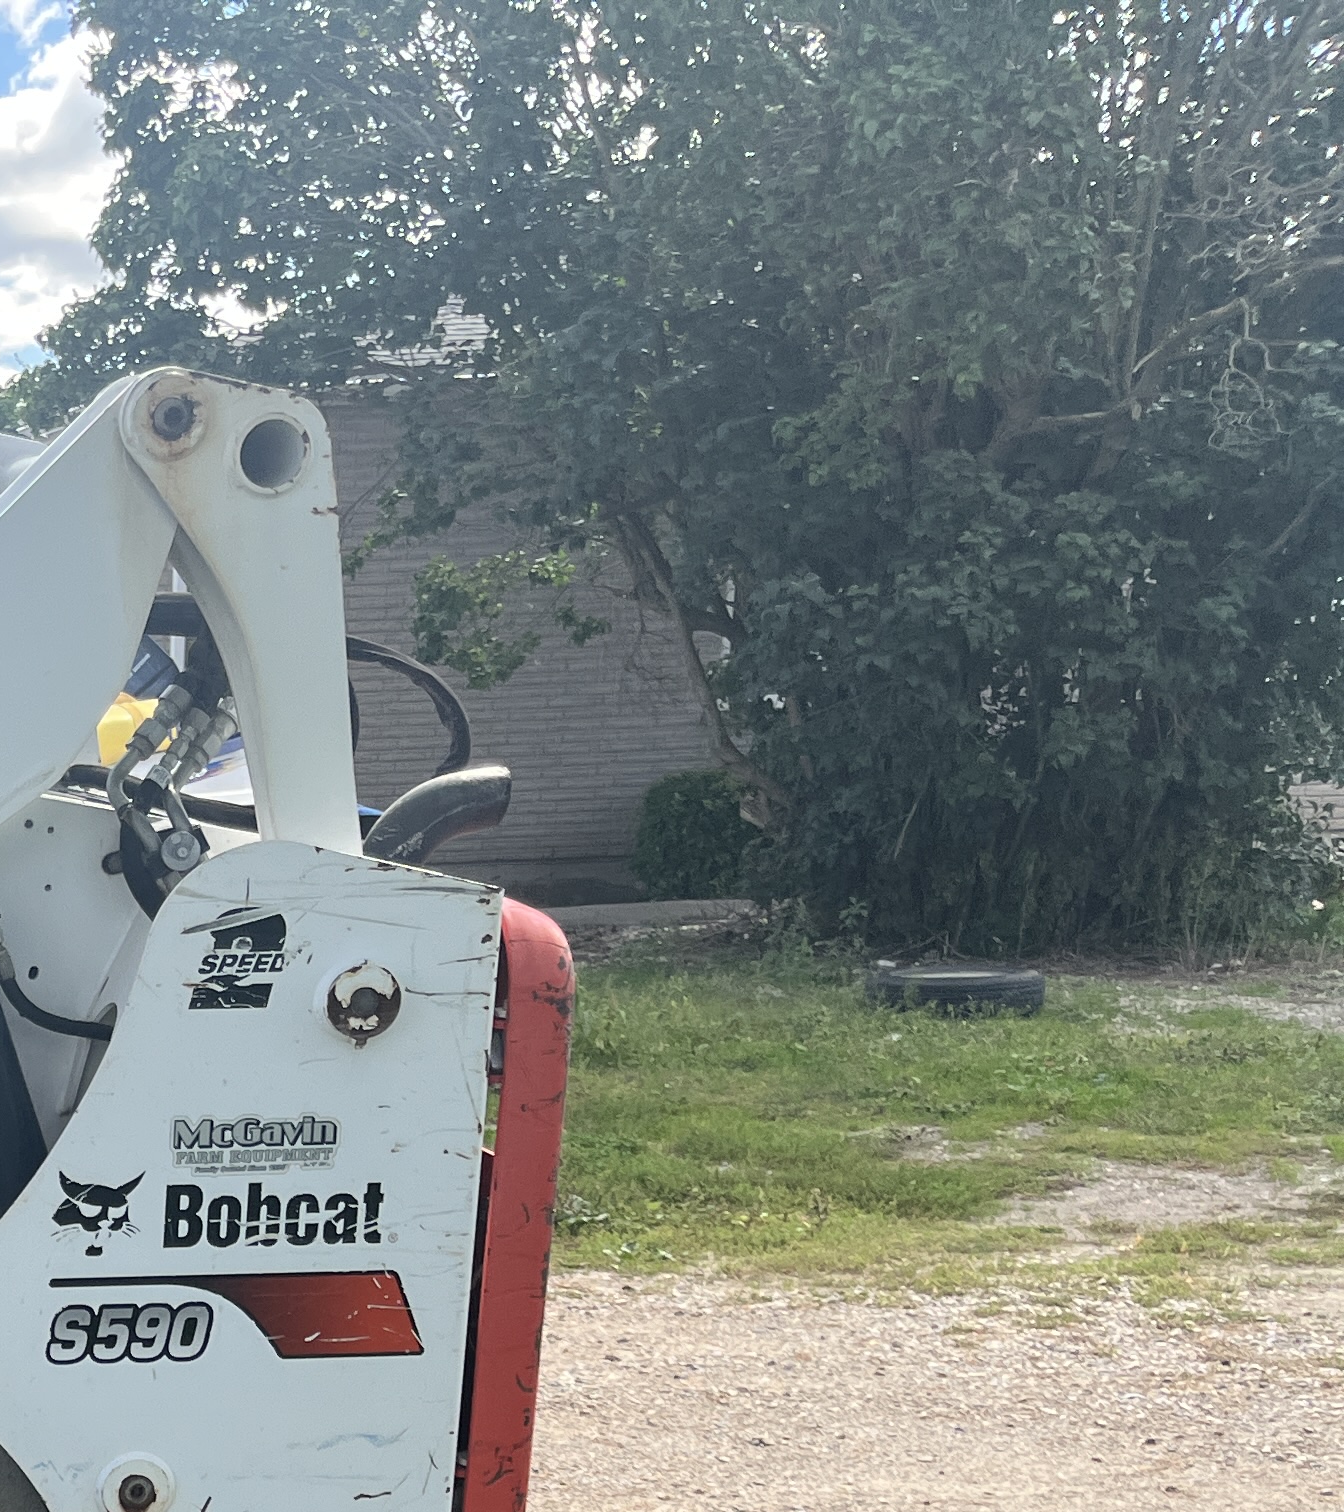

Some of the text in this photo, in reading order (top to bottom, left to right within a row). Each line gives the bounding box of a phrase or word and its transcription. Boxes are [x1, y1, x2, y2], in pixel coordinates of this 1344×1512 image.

[197, 952, 285, 975] SPEED
[173, 1115, 337, 1150] McGavin
[176, 1151, 224, 1165] FARM
[229, 1147, 334, 1164] EQUIPMENT
[163, 1182, 384, 1248] Bobcat
[45, 1301, 213, 1365] S590
